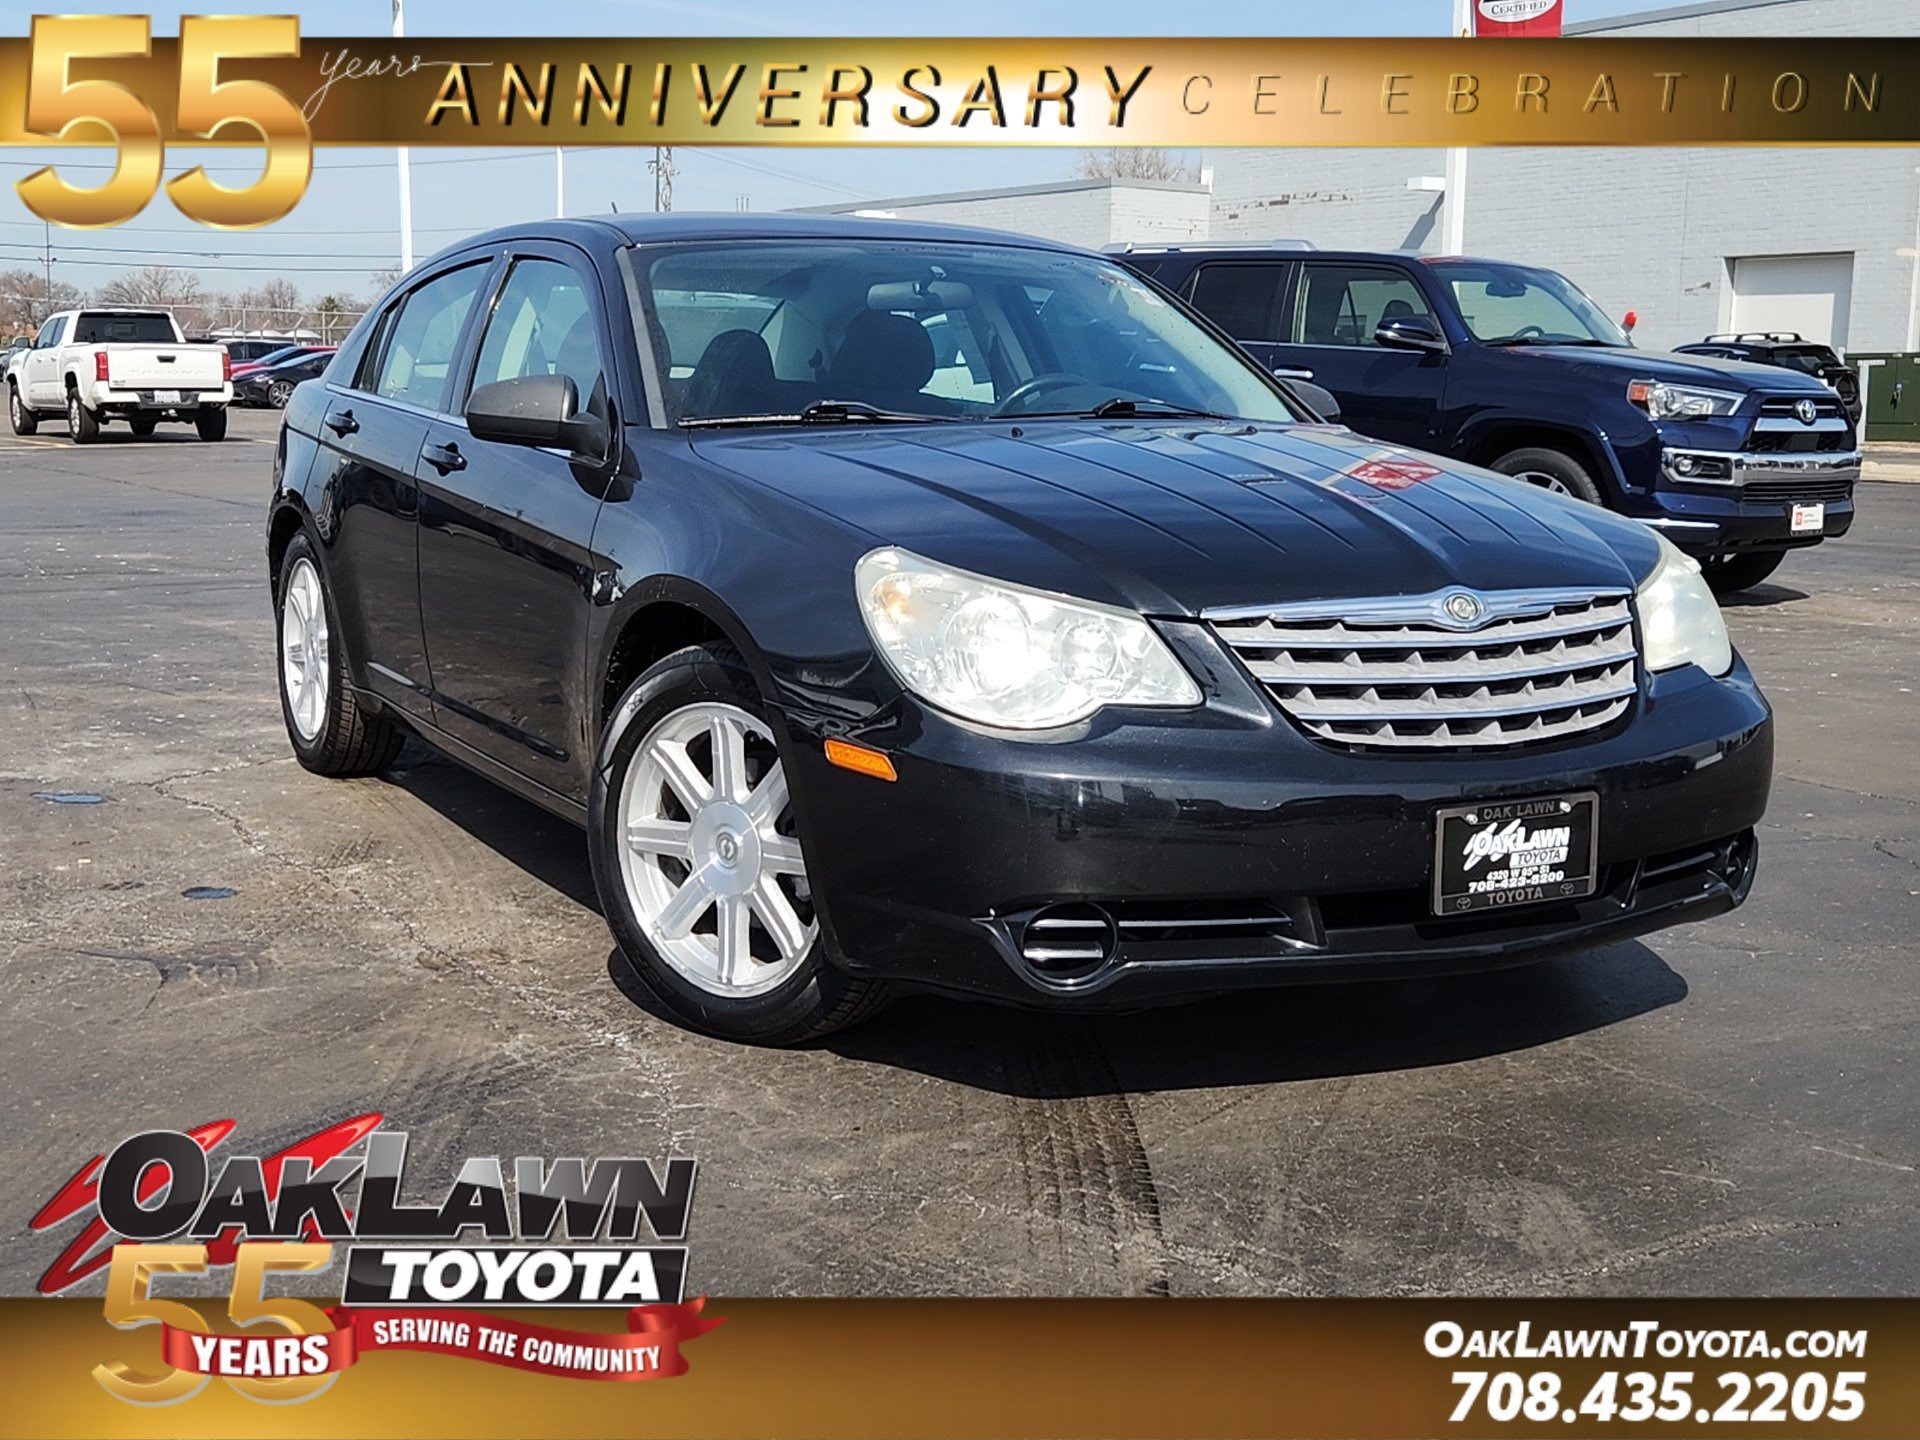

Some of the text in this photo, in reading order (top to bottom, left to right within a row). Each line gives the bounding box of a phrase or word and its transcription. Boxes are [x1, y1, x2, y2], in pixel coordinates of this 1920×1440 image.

[1491, 1, 1547, 15] CERTIFIED
[1483, 800, 1555, 820] OAK LAWN
[1517, 849, 1561, 865] TOYOTA
[1468, 870, 1565, 894] 708-423-5200
[1510, 868, 1521, 878] W
[1487, 886, 1544, 906] TOYOTA
